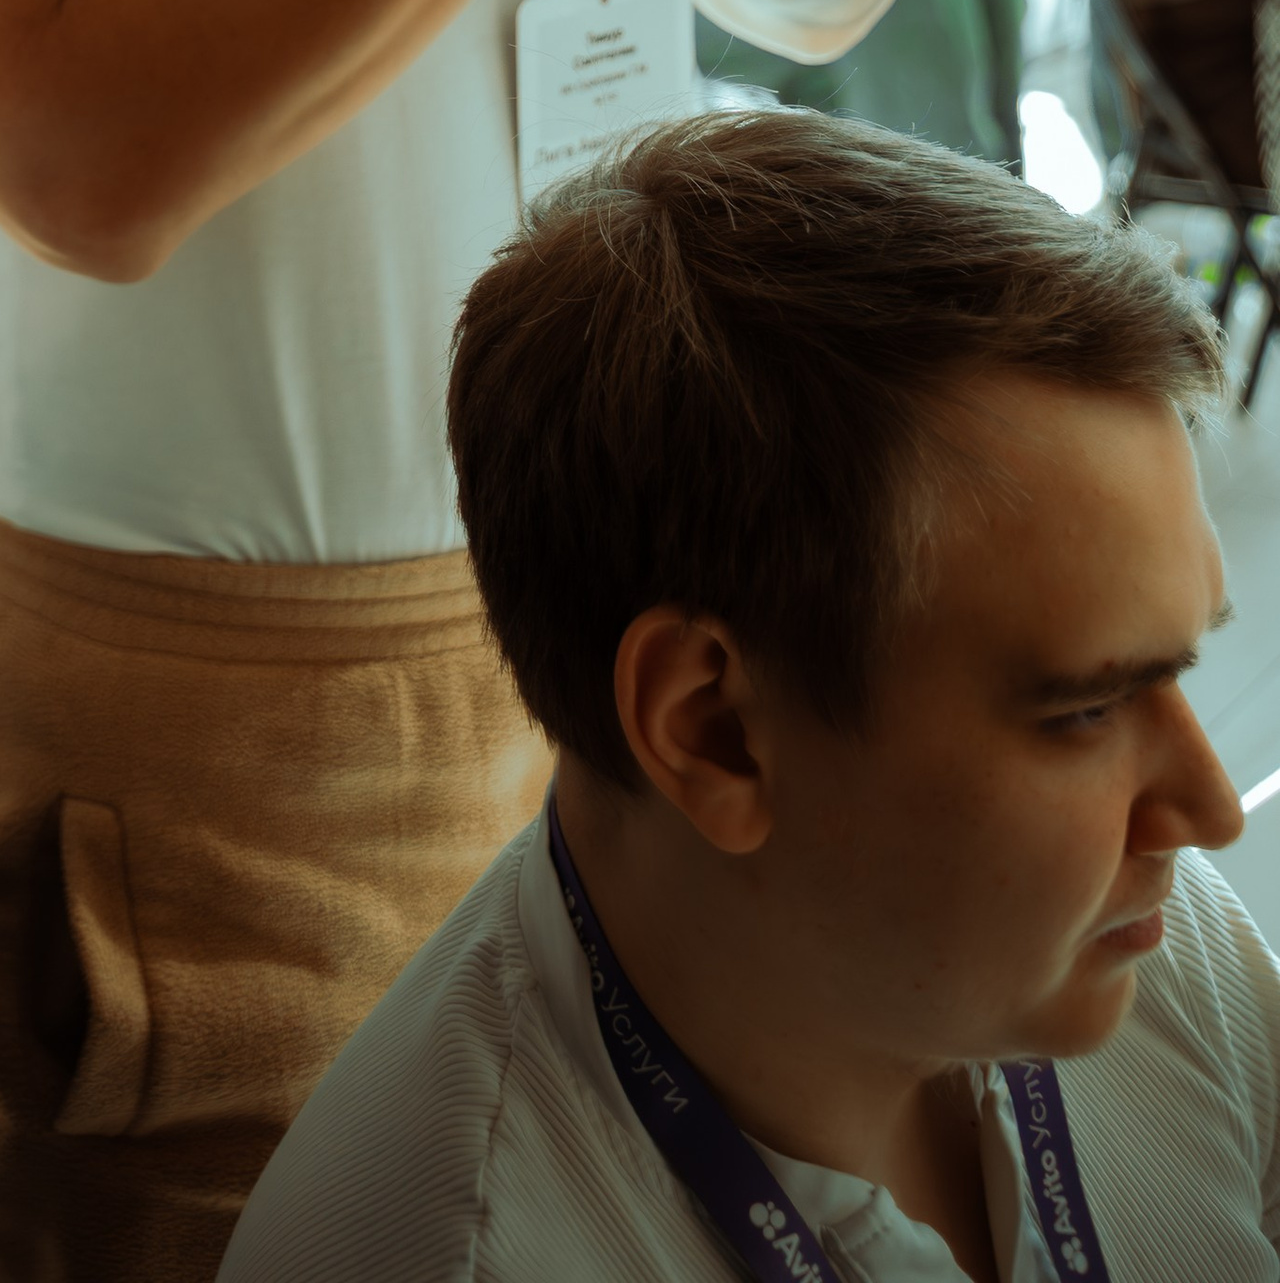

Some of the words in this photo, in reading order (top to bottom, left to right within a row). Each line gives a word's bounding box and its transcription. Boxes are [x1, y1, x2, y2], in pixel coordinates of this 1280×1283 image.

[601, 986, 689, 1114] Услуги
[1019, 1060, 1052, 1149] Услу
[1040, 1148, 1077, 1236] Avito
[772, 1232, 824, 1283] Avi
